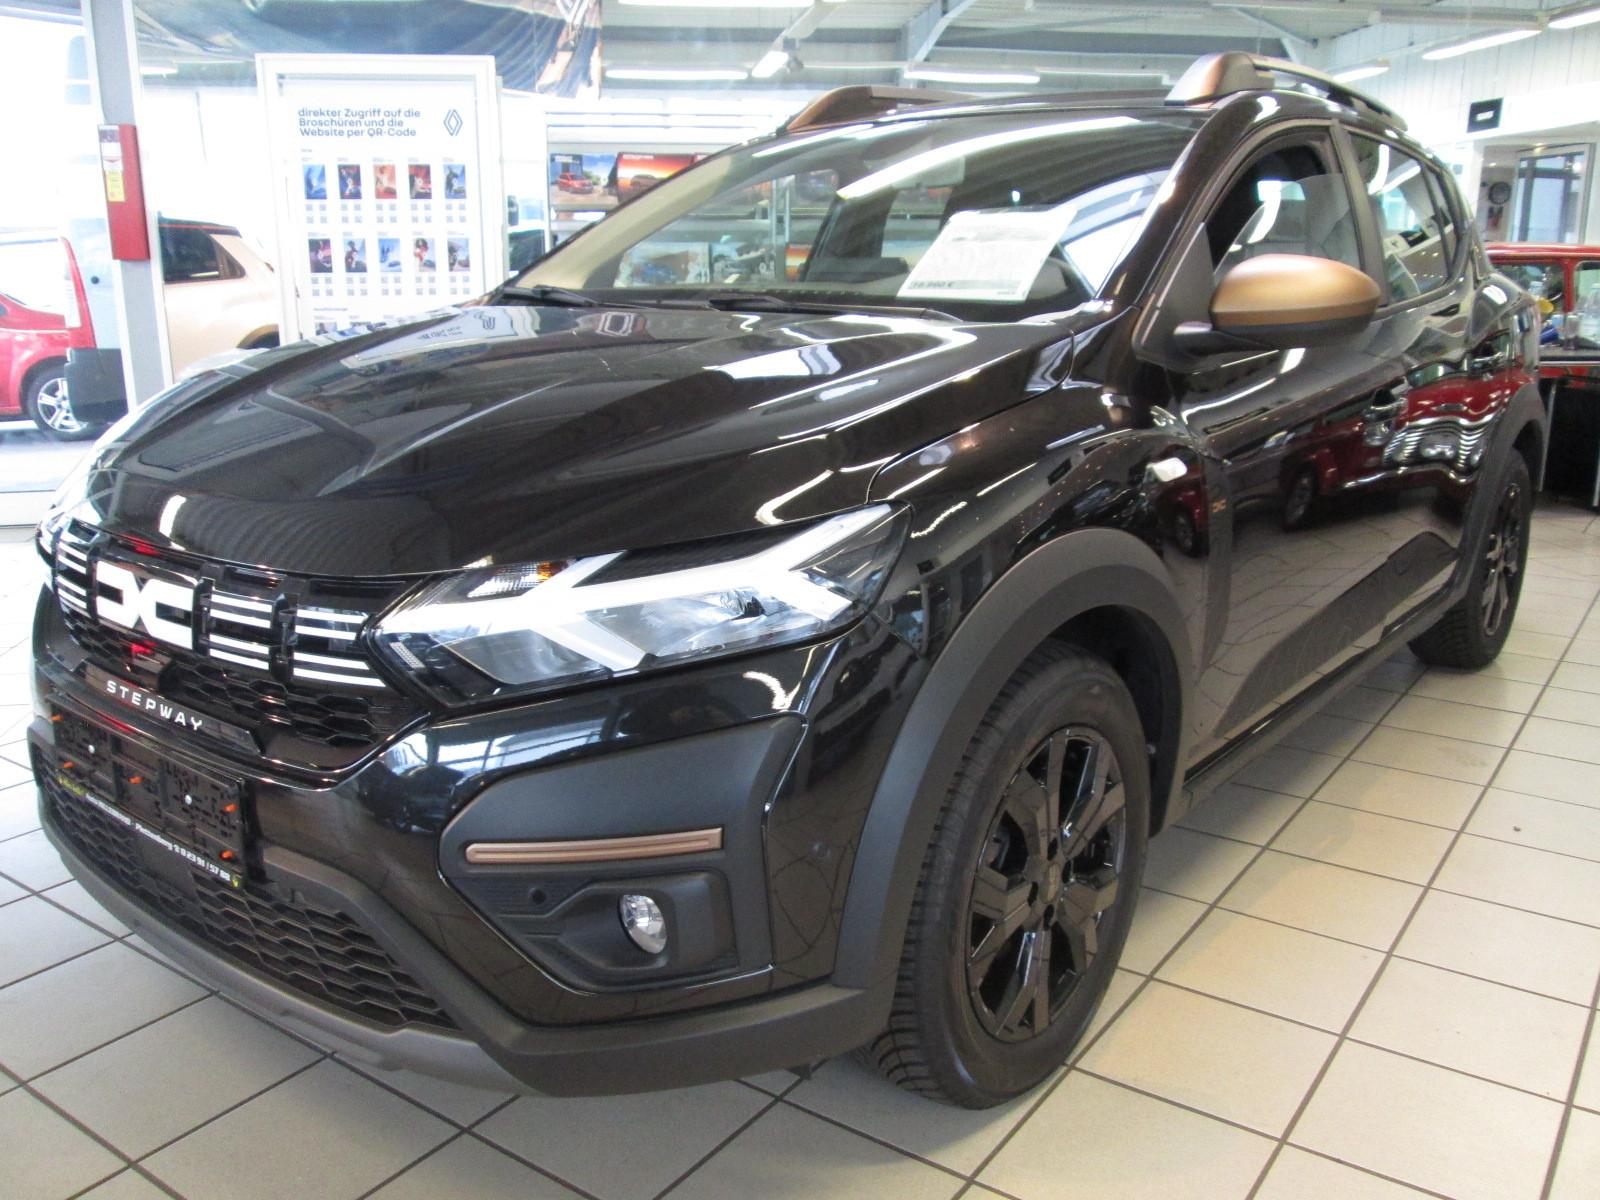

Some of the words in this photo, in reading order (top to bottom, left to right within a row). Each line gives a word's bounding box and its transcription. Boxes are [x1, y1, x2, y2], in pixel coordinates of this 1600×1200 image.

[298, 108, 341, 118] direkter
[344, 108, 381, 119] Zugriff
[384, 108, 402, 118] auf
[404, 108, 421, 118] die
[299, 117, 362, 128] Broschüren
[364, 118, 385, 128] und
[387, 117, 404, 128] die
[299, 127, 345, 137] Website
[347, 129, 365, 139] per
[367, 127, 417, 138] QR-Code
[106, 680, 203, 731] STEPWAY
